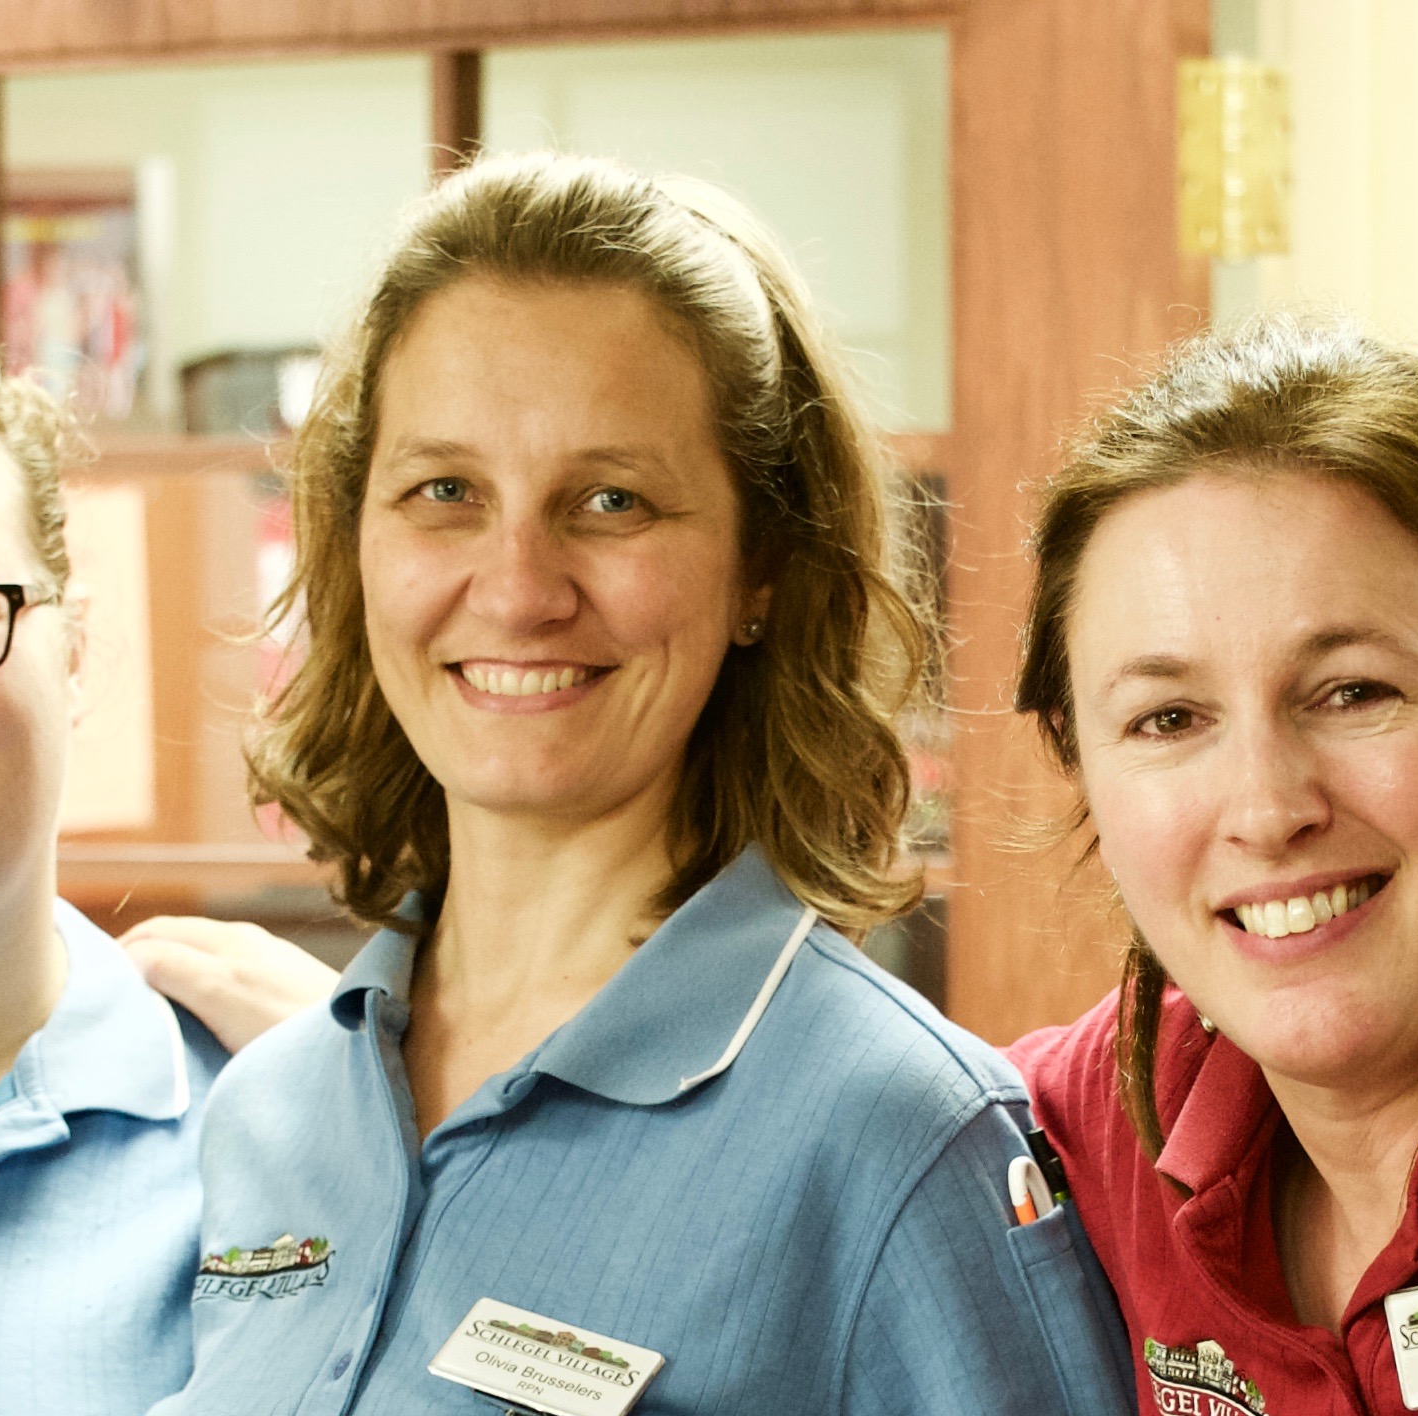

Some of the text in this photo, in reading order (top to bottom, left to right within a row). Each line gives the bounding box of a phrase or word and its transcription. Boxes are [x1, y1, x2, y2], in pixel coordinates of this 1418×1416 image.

[466, 1320, 640, 1387] SCHLEGEL VILLAGES
[475, 1351, 603, 1401] Olivia Brusselers
[516, 1380, 544, 1396] RPN
